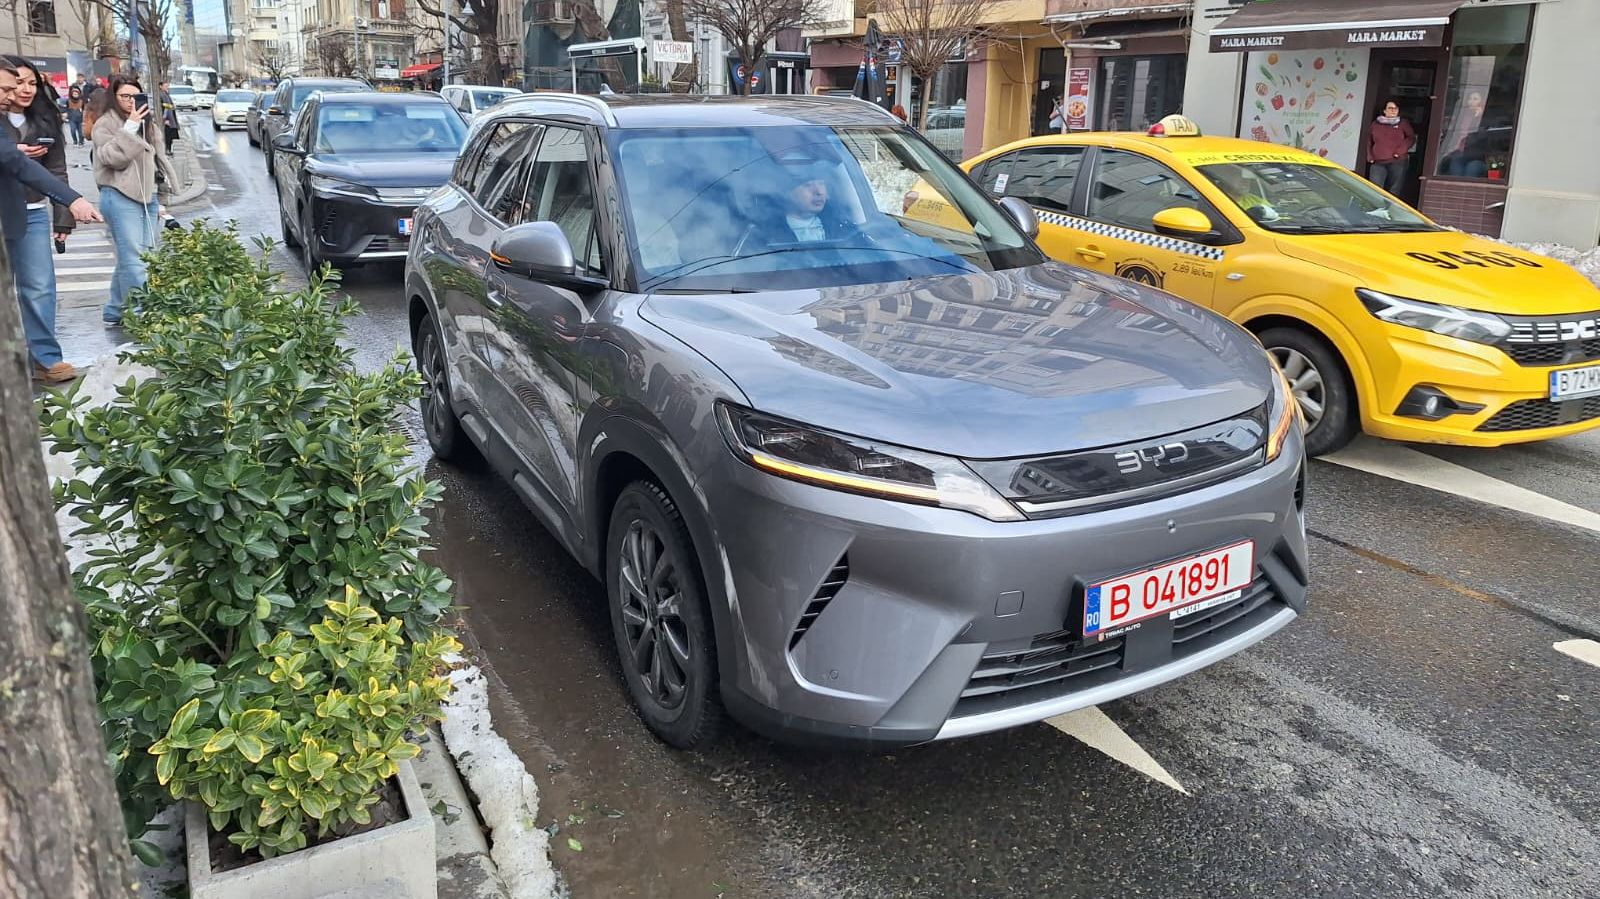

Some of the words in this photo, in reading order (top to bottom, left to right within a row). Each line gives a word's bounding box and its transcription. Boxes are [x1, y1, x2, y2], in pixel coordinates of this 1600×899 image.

[1221, 38, 1245, 47] MARA
[1247, 36, 1284, 46] MARKET
[1347, 32, 1378, 43] MARA
[1379, 30, 1426, 42] MARKET
[657, 42, 688, 54] VICTORIA
[1170, 118, 1193, 133] TAXI
[1406, 250, 1544, 270] 9466
[1560, 373, 1569, 392] B
[1113, 442, 1188, 475] BYD
[1110, 583, 1131, 621] B
[1142, 553, 1230, 610] 041891
[1086, 611, 1099, 627] RO
[1125, 622, 1142, 632] AUTO
